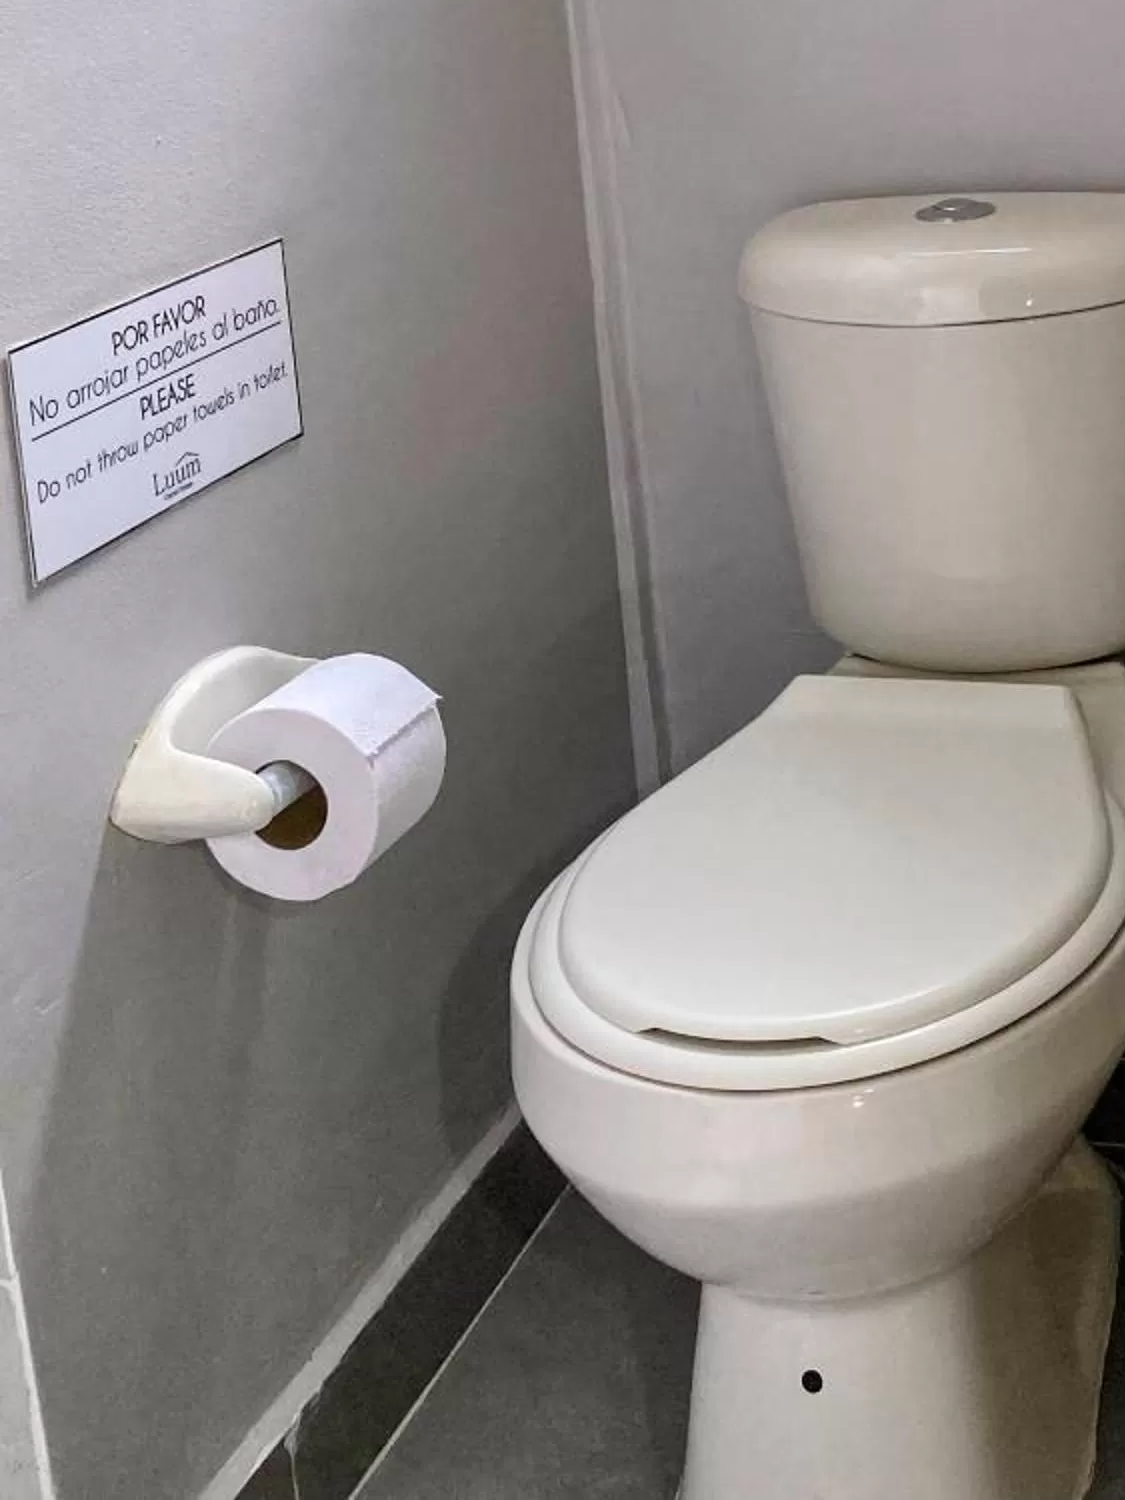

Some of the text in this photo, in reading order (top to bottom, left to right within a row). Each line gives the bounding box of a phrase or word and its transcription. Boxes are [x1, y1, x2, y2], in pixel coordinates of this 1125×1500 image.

[29, 398, 59, 426] No
[66, 367, 130, 409] arrojar
[136, 335, 207, 381] papeles
[213, 312, 229, 340] al
[112, 295, 206, 356] POR FAVOR
[140, 373, 197, 421] PLEASE
[37, 479, 62, 504] Do
[65, 461, 93, 488] not
[97, 445, 139, 474] throw
[144, 417, 188, 451] paper
[193, 395, 235, 422] towels
[238, 381, 251, 399] in
